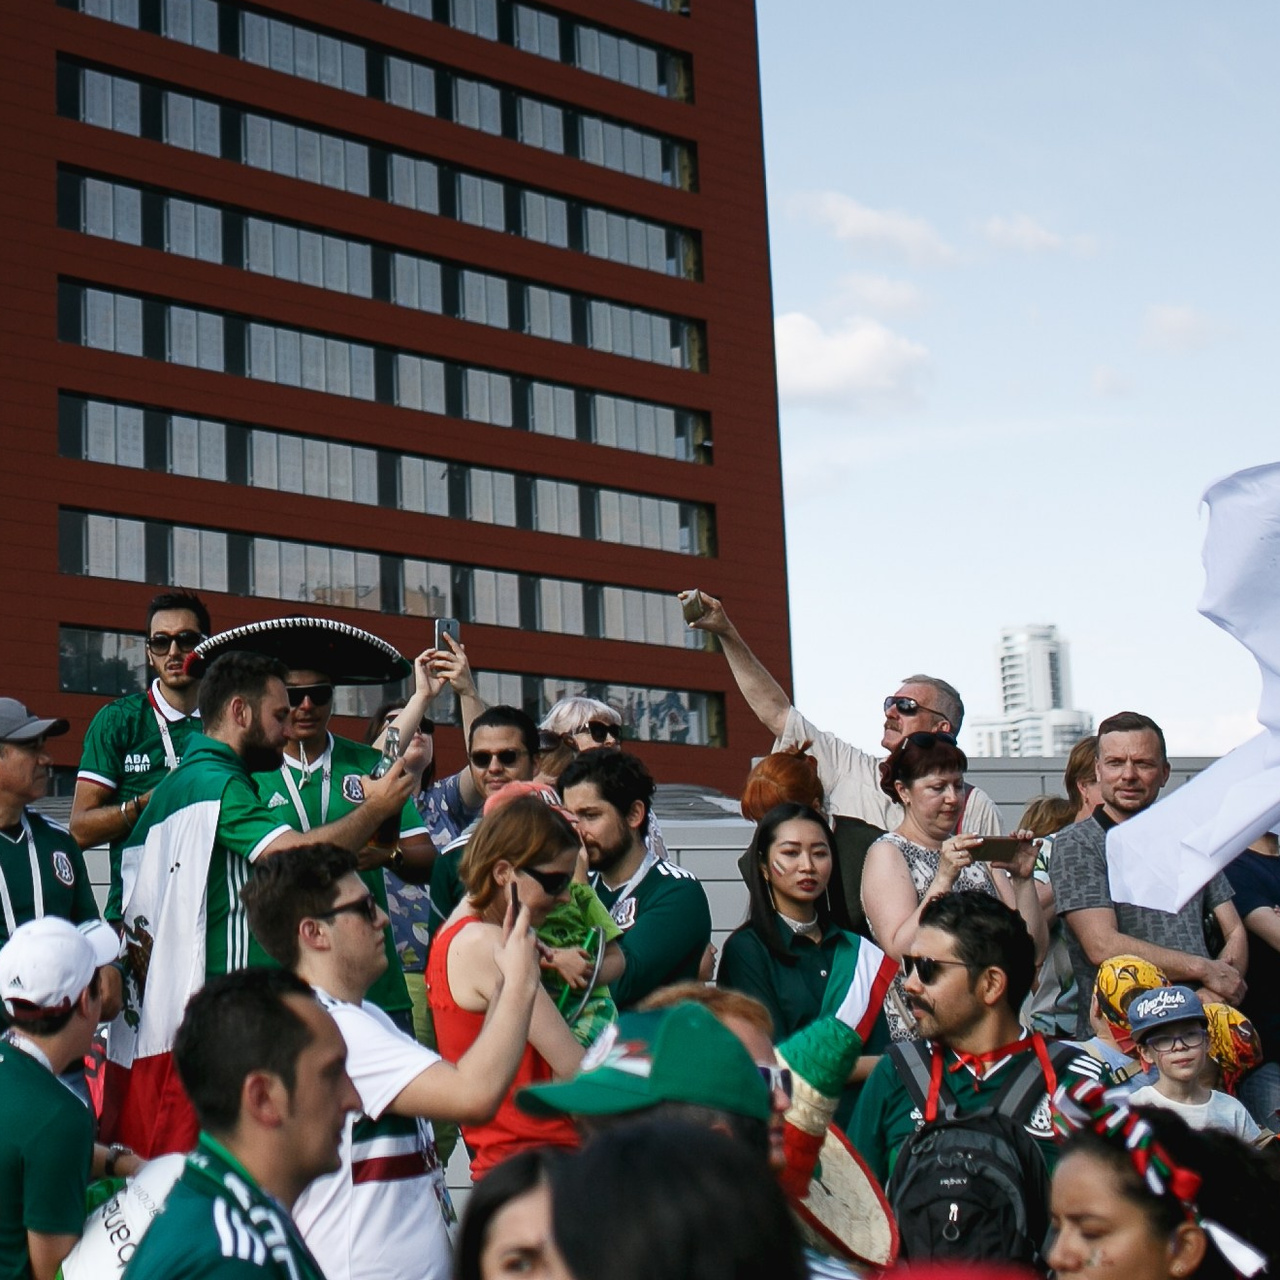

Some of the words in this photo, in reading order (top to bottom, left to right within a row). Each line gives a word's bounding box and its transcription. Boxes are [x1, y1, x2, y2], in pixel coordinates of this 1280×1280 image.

[125, 754, 150, 764] ABA
[125, 764, 151, 772] SPORT
[1151, 990, 1186, 1015] York
